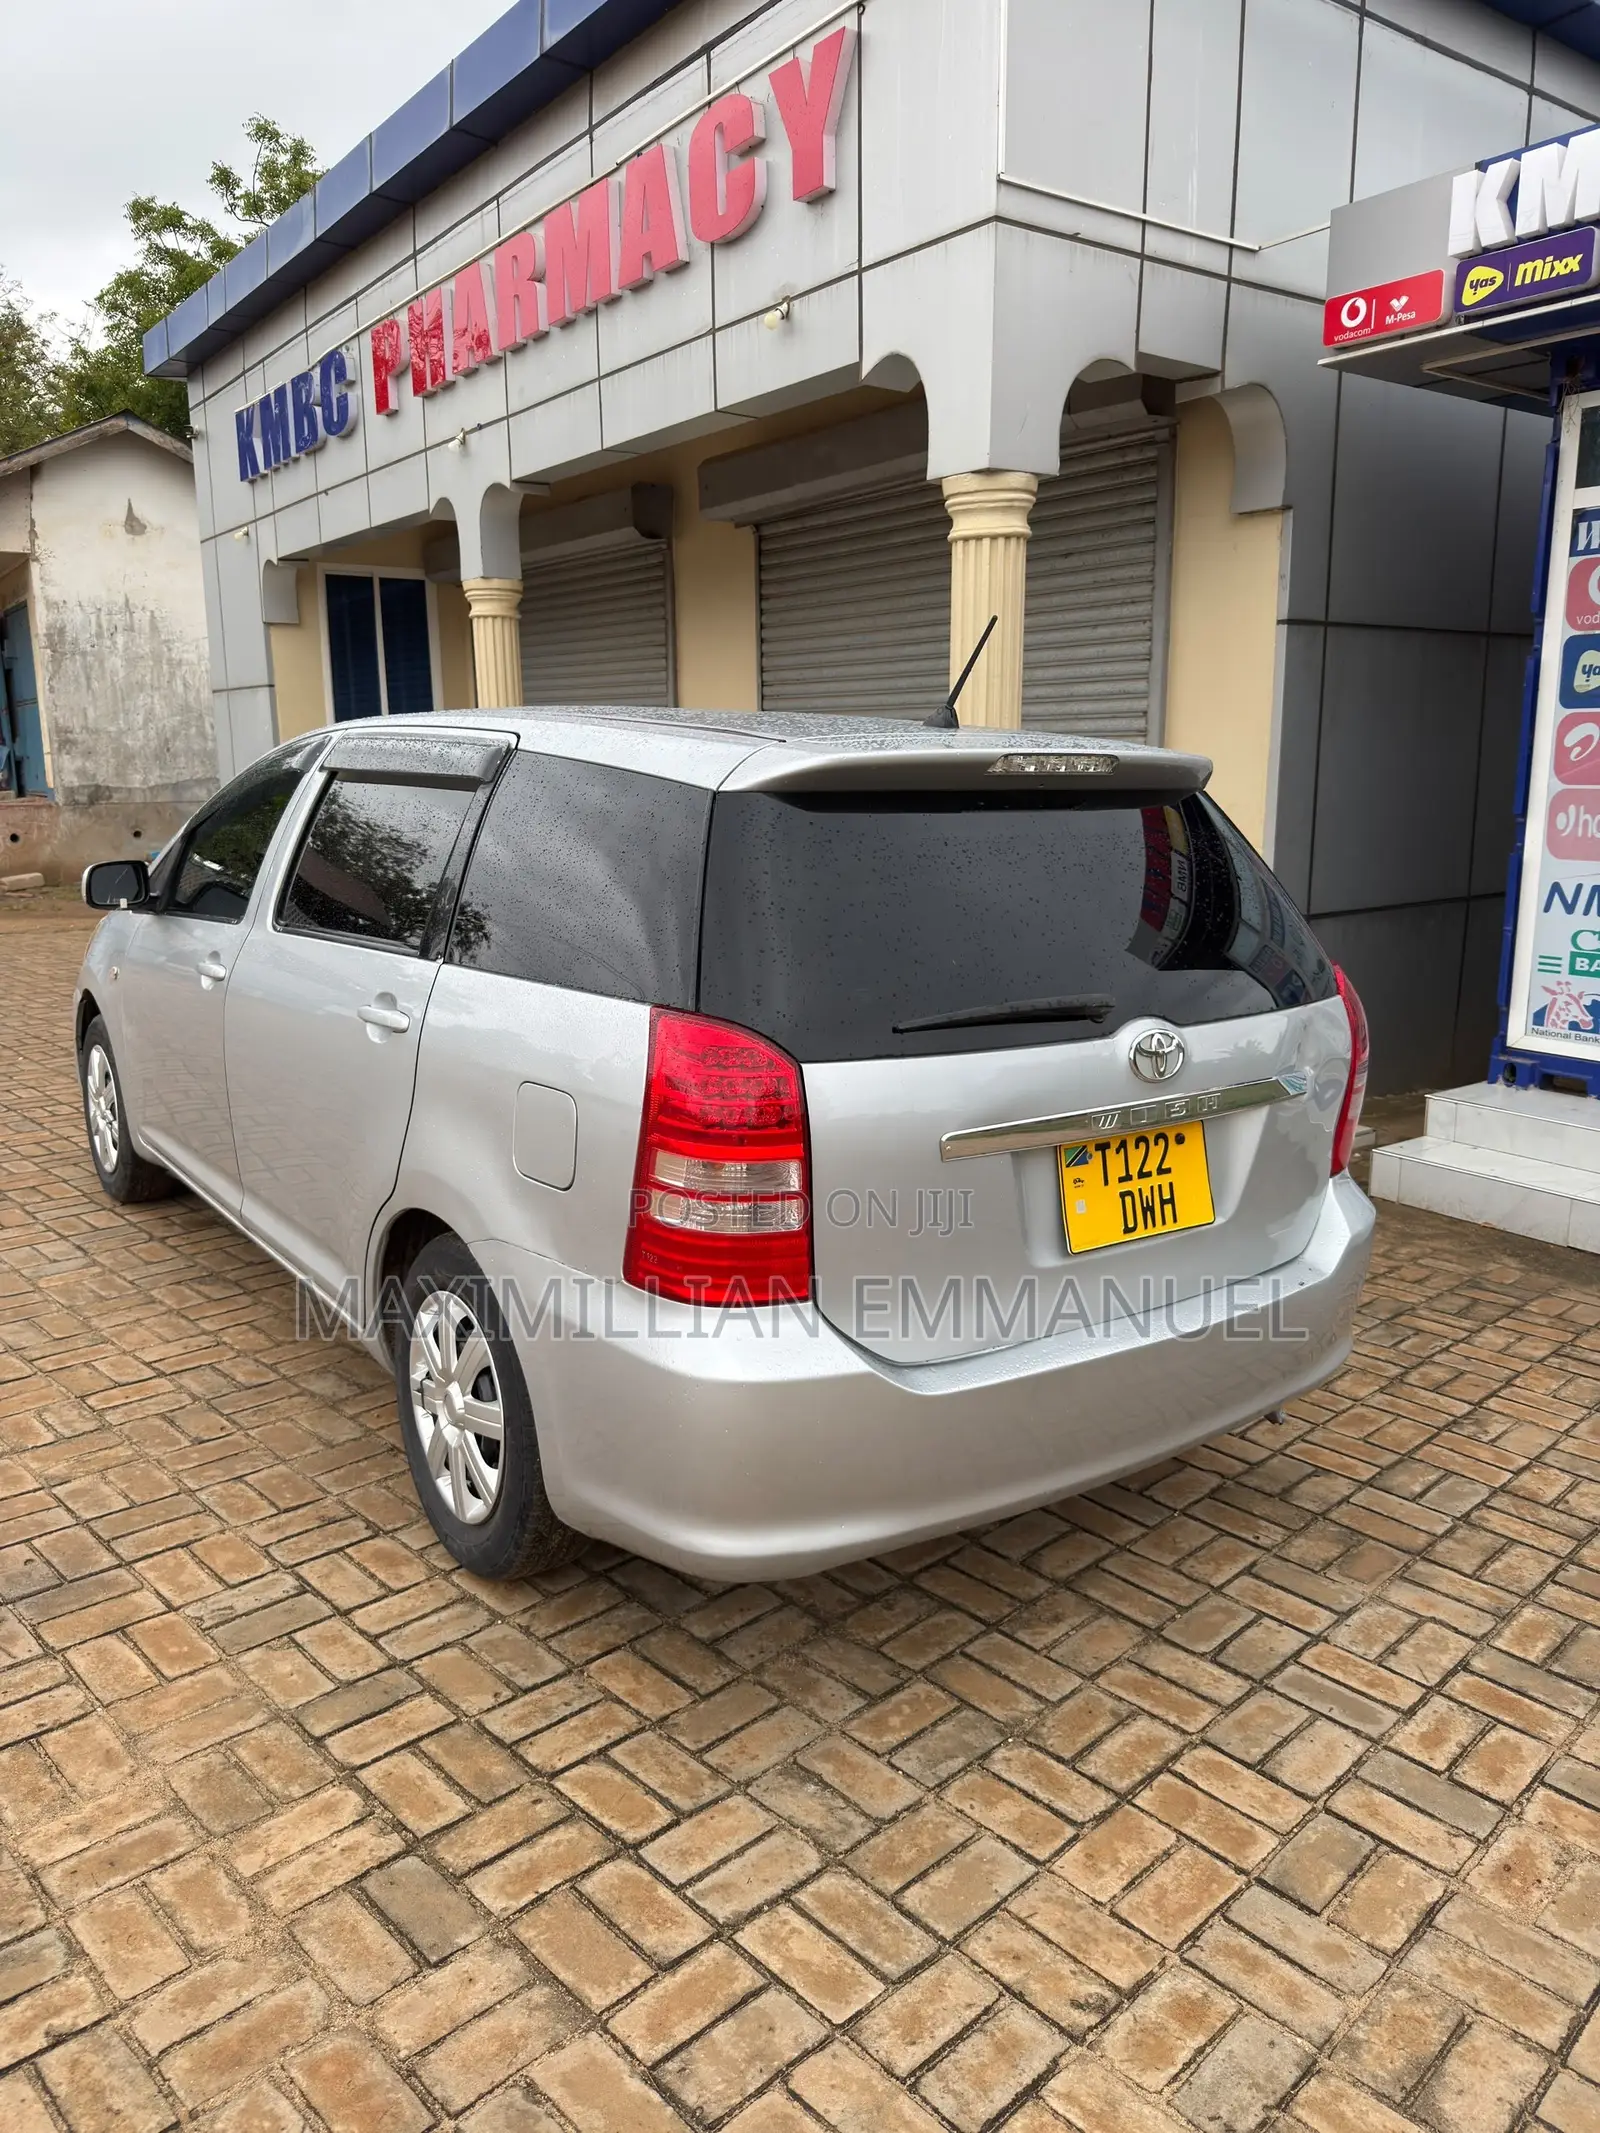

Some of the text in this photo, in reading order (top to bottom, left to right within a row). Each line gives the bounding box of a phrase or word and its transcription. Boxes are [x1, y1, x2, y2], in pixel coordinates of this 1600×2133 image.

[235, 26, 857, 483] KMBC PHARMACY
[1469, 253, 1583, 295] yas mixx
[1334, 327, 1371, 342] vodacom
[1385, 310, 1416, 325] M-Pesa
[1531, 1027, 1571, 1040] National
[1095, 1132, 1172, 1186] T122
[1119, 1182, 1178, 1234] DWH
